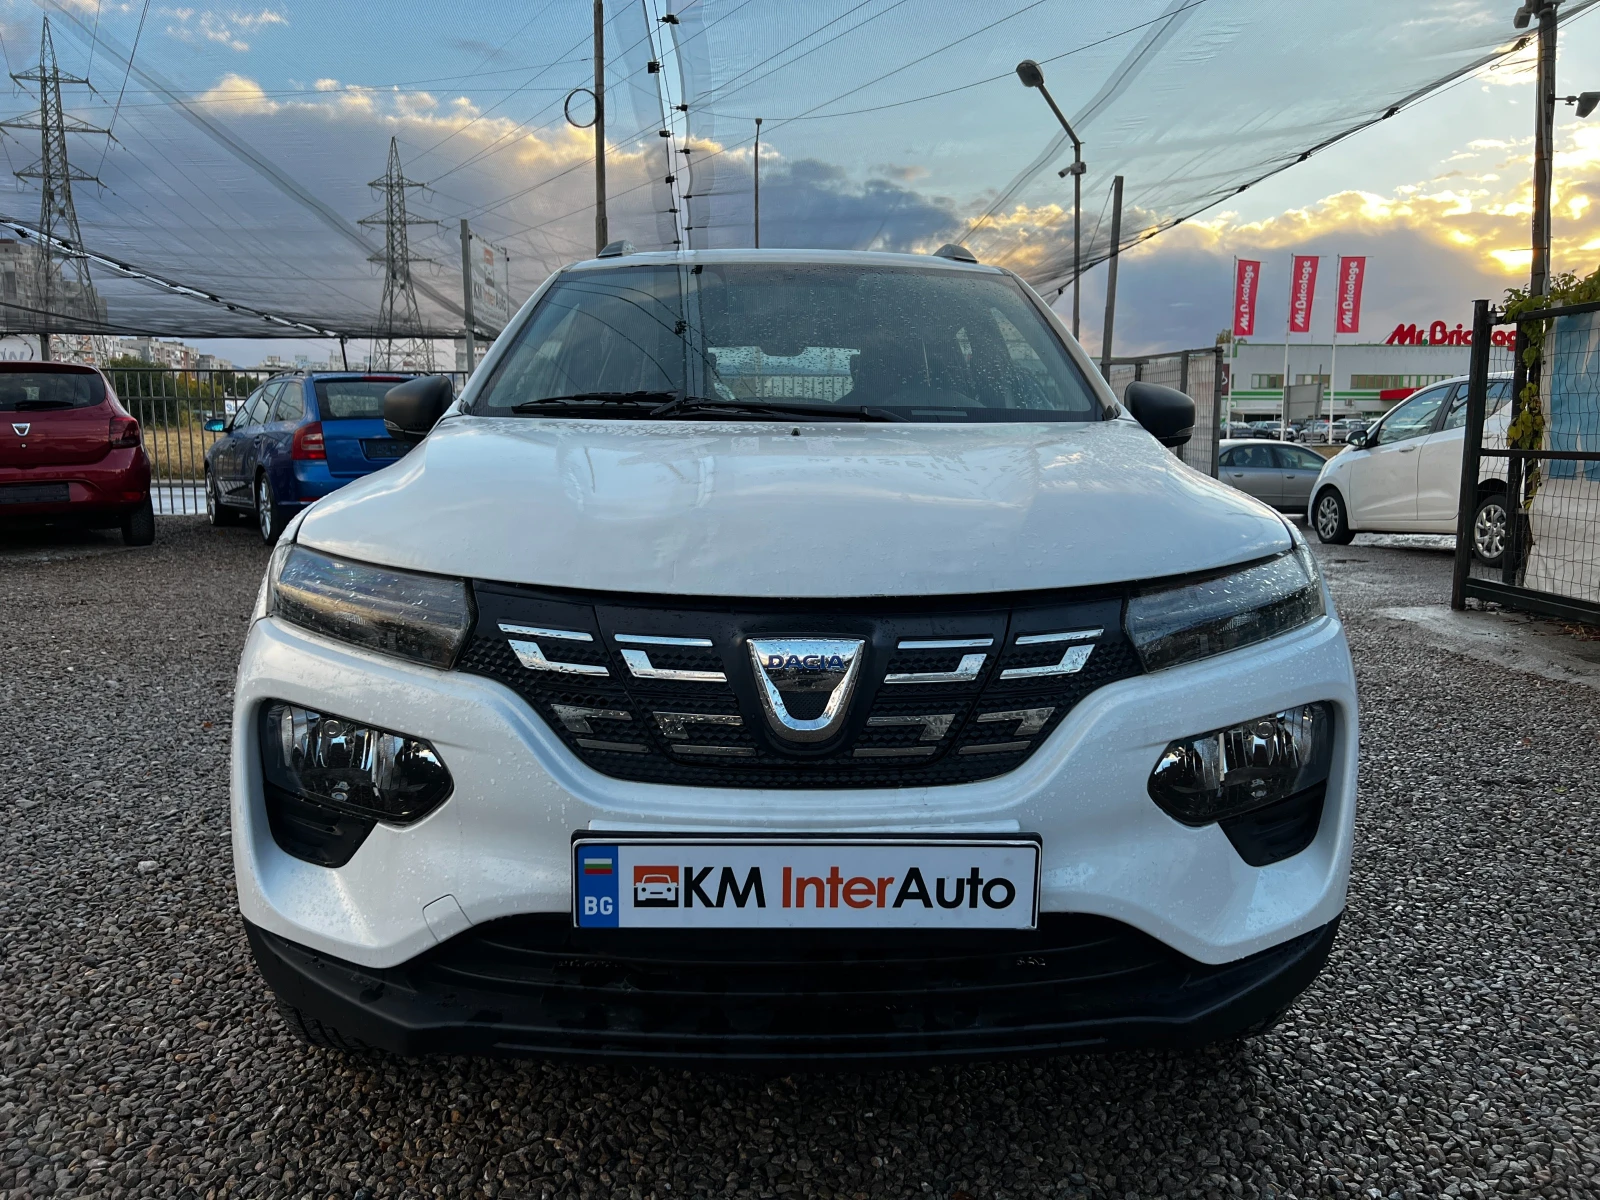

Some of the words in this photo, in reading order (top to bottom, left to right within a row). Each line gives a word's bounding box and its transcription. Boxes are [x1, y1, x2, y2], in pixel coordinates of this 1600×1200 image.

[768, 655, 845, 670] DACIA
[684, 867, 766, 908] KM
[782, 866, 1016, 909] InterAuto
[584, 896, 613, 915] BG
